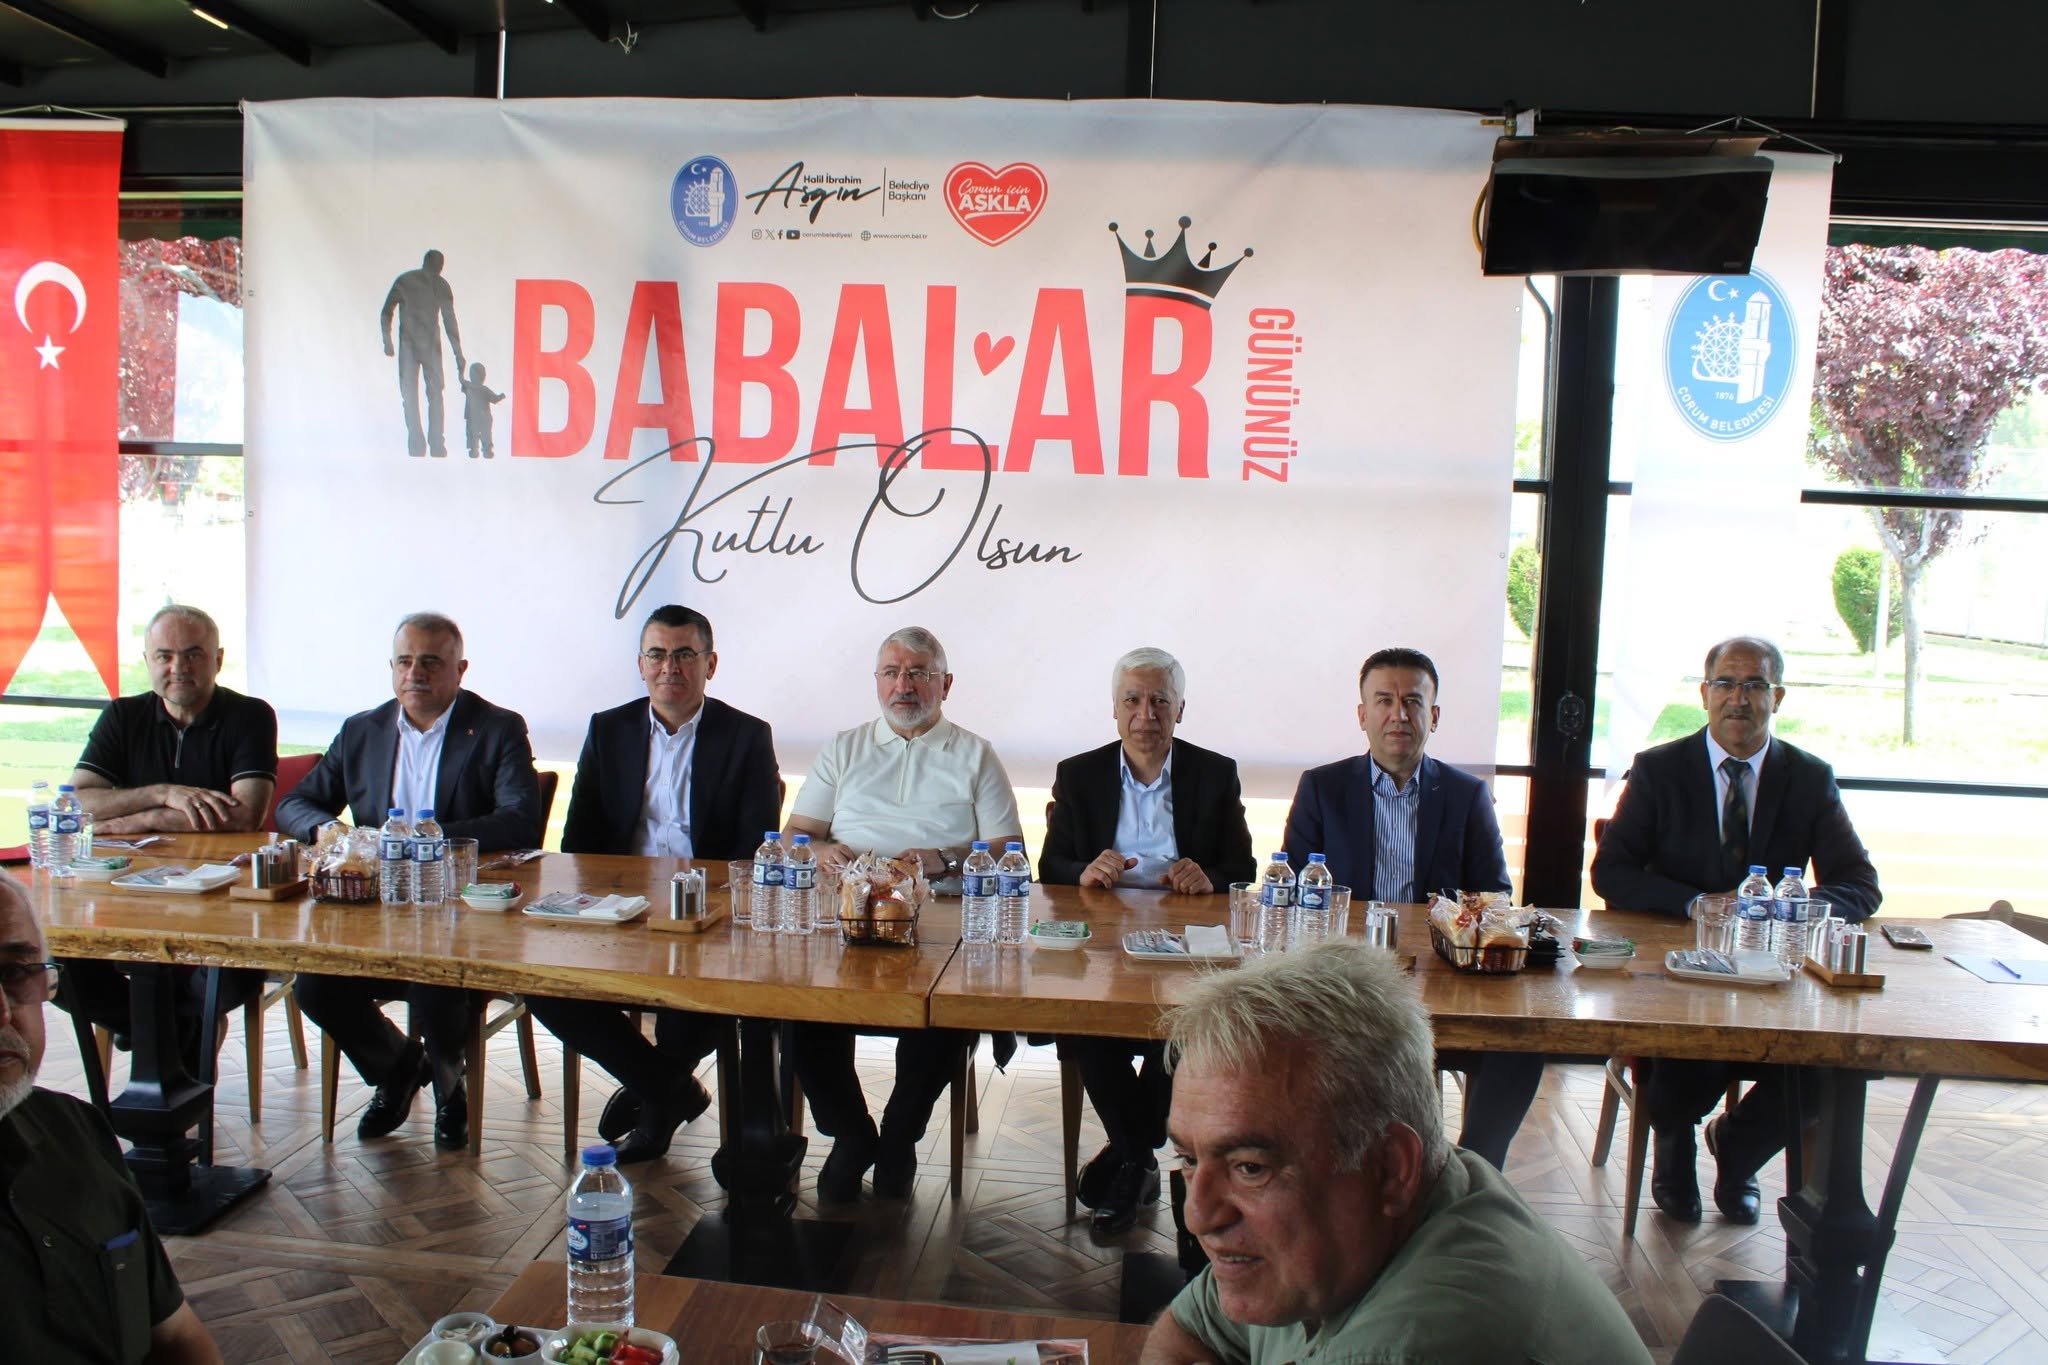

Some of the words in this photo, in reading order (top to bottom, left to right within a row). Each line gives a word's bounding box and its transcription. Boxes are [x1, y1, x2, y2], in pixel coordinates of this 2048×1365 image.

[803, 174, 824, 185] Halil
[826, 173, 862, 185] İbrahim
[888, 180, 930, 191] Belediye
[888, 191, 926, 202] Başkanı
[510, 278, 1213, 479] BABALAR
[1242, 307, 1303, 483] GÜNÜNÜZ
[594, 436, 913, 620] Kutlu
[851, 427, 1082, 604] Olsun
